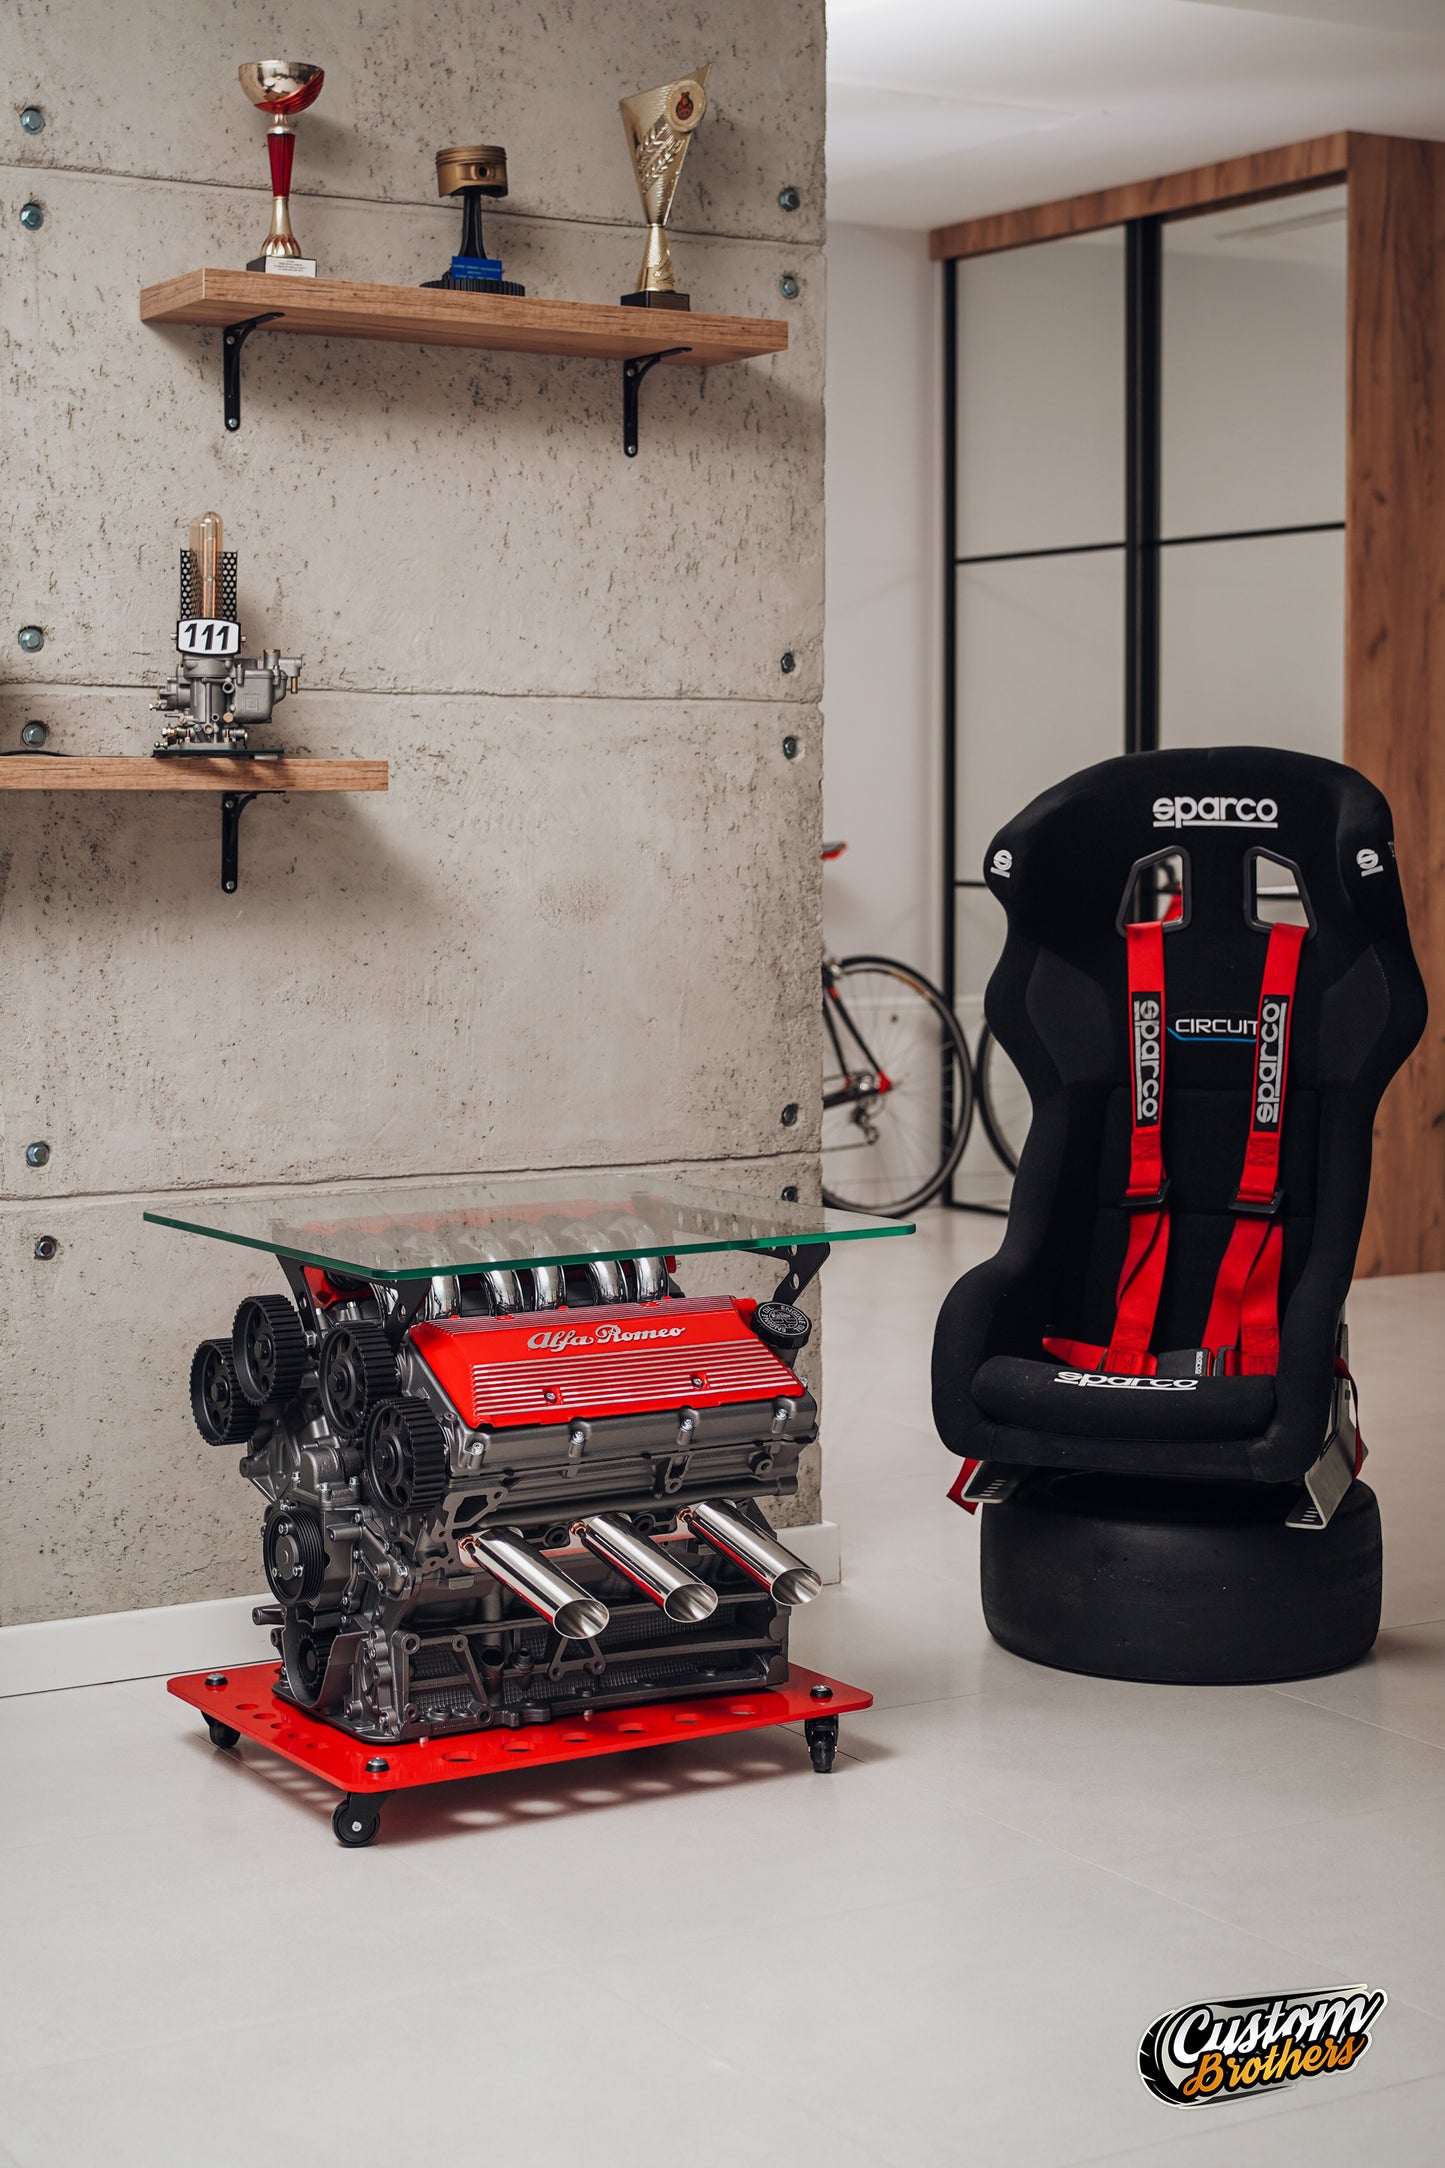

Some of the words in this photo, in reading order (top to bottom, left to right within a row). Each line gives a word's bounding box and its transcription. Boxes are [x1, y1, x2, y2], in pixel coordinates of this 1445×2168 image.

[184, 623, 230, 651] 111
[1152, 796, 1278, 828] sparco
[1134, 1000, 1160, 1120] sparco
[1256, 1002, 1287, 1123] sparco
[527, 1329, 594, 1352] Alfa
[595, 1324, 686, 1344] Romeo
[1054, 1371, 1198, 1391] sparco
